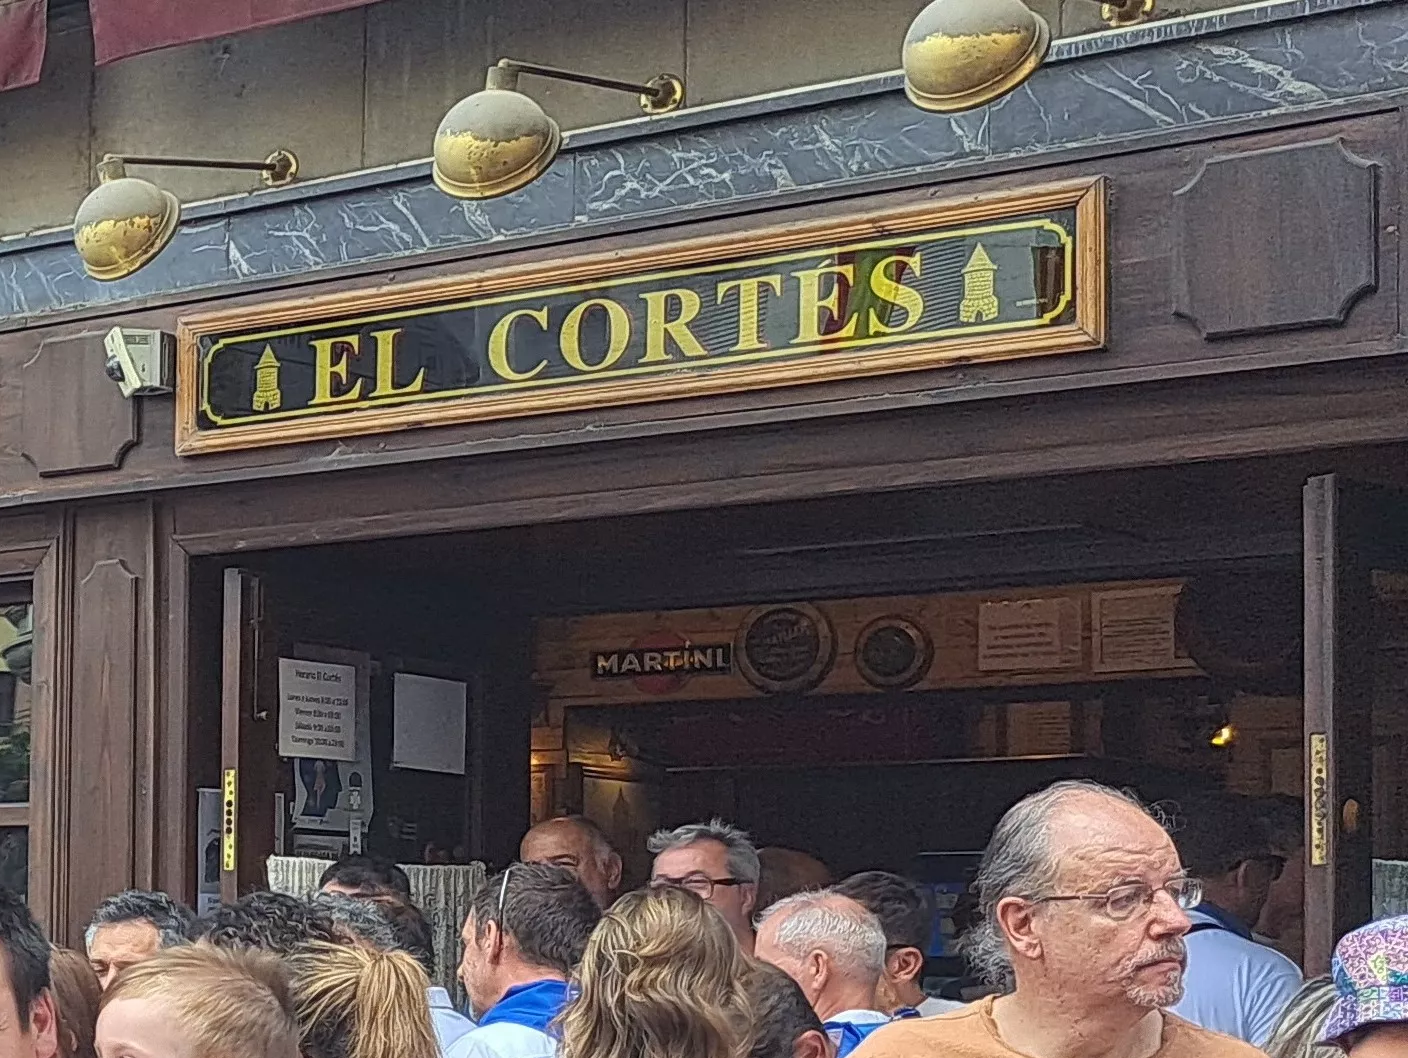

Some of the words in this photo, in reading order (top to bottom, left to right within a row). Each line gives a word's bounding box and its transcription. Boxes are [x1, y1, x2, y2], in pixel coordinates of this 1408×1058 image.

[308, 328, 425, 406] EL
[487, 252, 924, 382] CORTÉS
[596, 647, 731, 676] MARTINI
